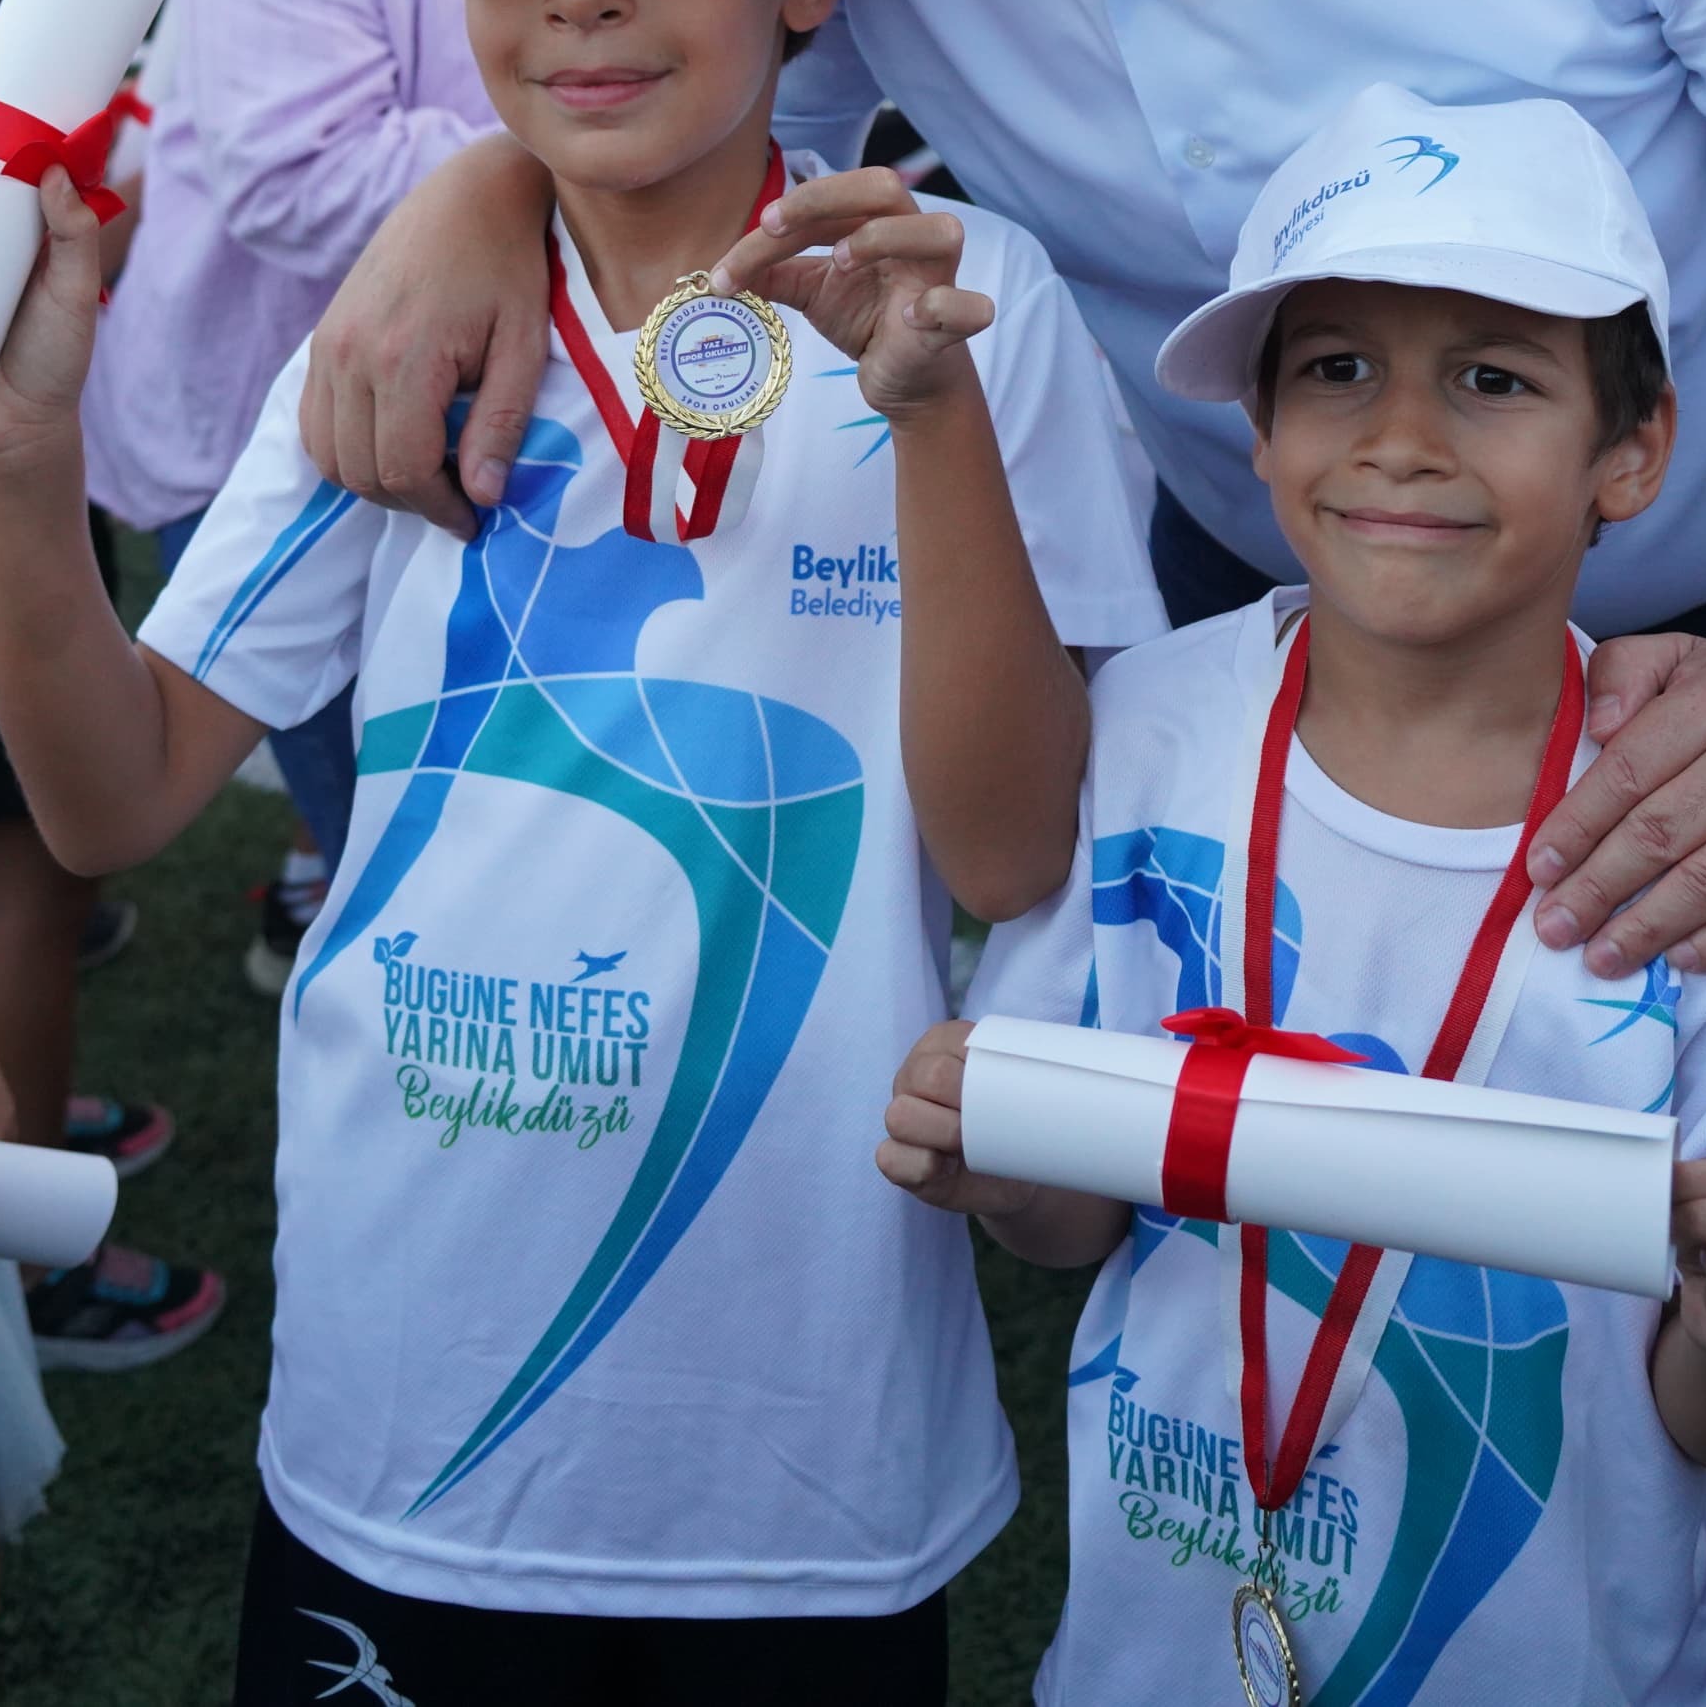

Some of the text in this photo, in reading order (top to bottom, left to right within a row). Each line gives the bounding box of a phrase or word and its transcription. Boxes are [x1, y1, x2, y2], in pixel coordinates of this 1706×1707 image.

[660, 300, 765, 361] BEYLİKDÜZÜ BELEDİYESİ
[679, 344, 747, 364] SPOR OKULLARI
[680, 380, 760, 412] SPOR OKULLARI
[792, 544, 898, 589] Beylik
[790, 586, 901, 626] Belediye
[384, 958, 651, 1041] BUGÜNE NEFES
[383, 1006, 648, 1087] YARINA UMUT
[396, 1063, 636, 1150] Beylikdüzü
[1107, 1386, 1359, 1534] BUGÜNE FES
[1107, 1434, 1240, 1525] YARINA
